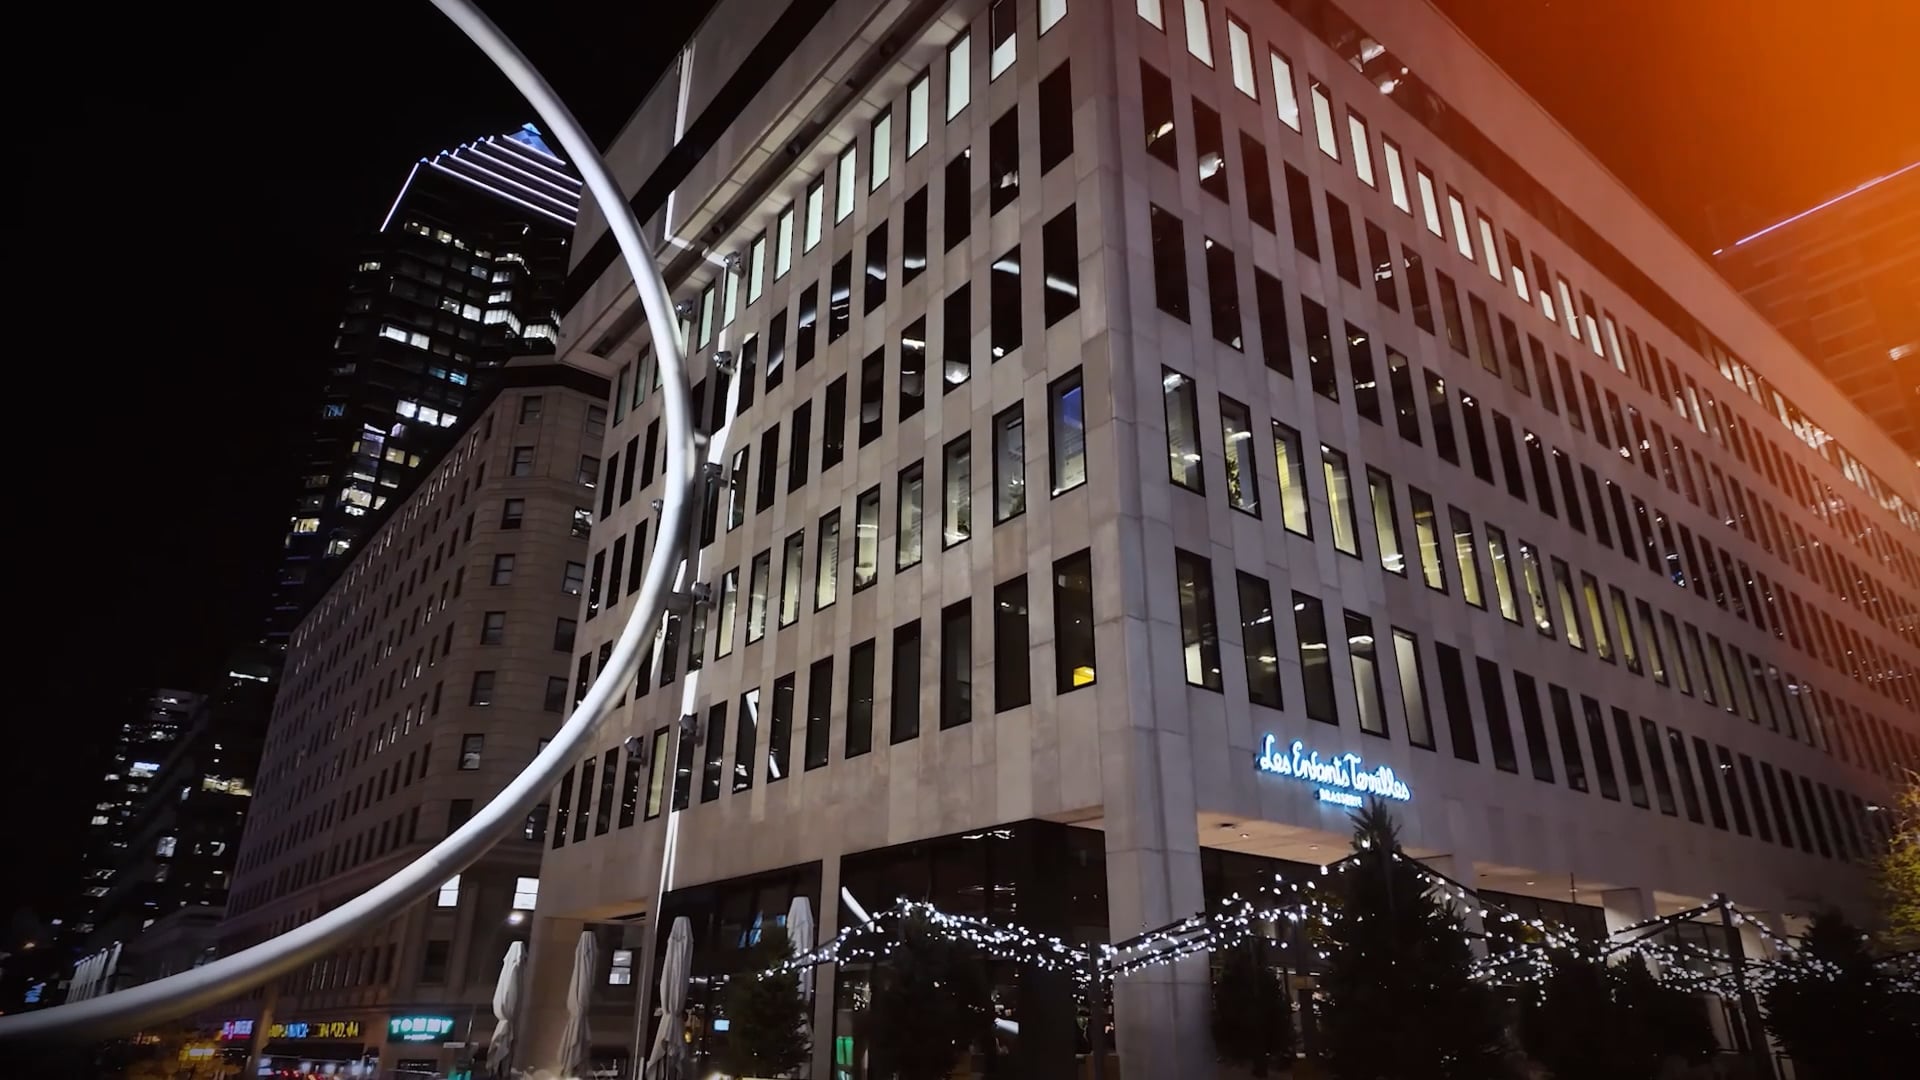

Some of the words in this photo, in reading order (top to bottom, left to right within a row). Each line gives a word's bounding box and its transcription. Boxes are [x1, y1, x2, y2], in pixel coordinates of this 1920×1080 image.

[1259, 733, 1292, 775] Les
[1292, 740, 1350, 788] Enfants
[391, 1018, 454, 1034] TOMMY
